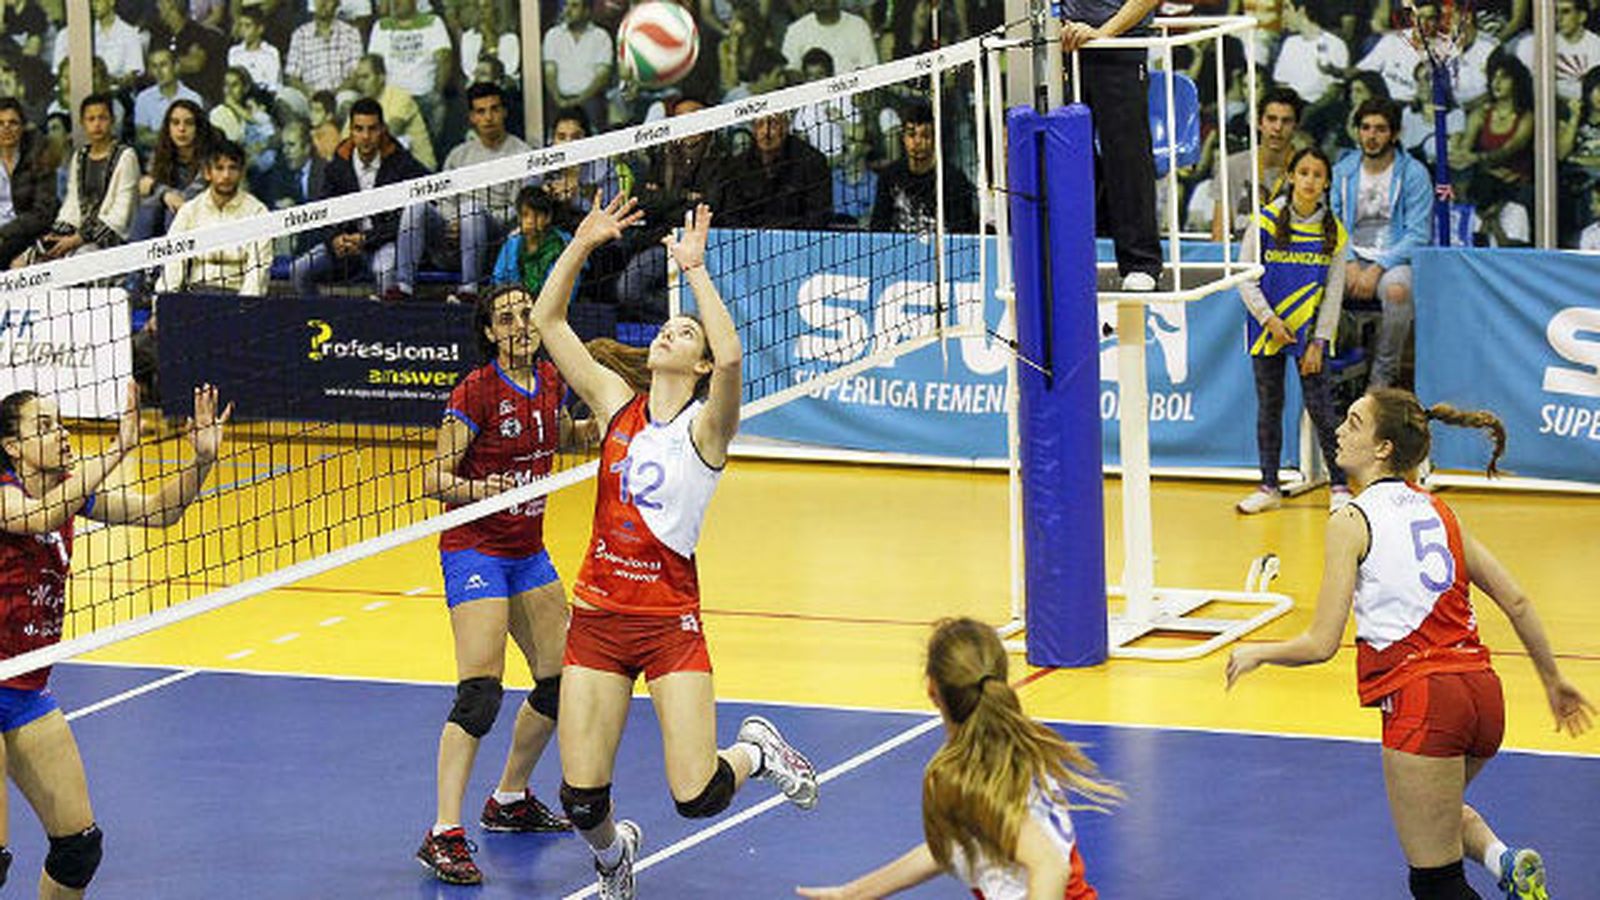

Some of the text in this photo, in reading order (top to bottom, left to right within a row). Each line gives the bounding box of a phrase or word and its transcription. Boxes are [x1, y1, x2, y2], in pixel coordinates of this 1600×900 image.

[368, 368, 460, 386] answer
[532, 410, 545, 444] 1
[610, 456, 666, 511] 12
[1410, 517, 1456, 592] 5
